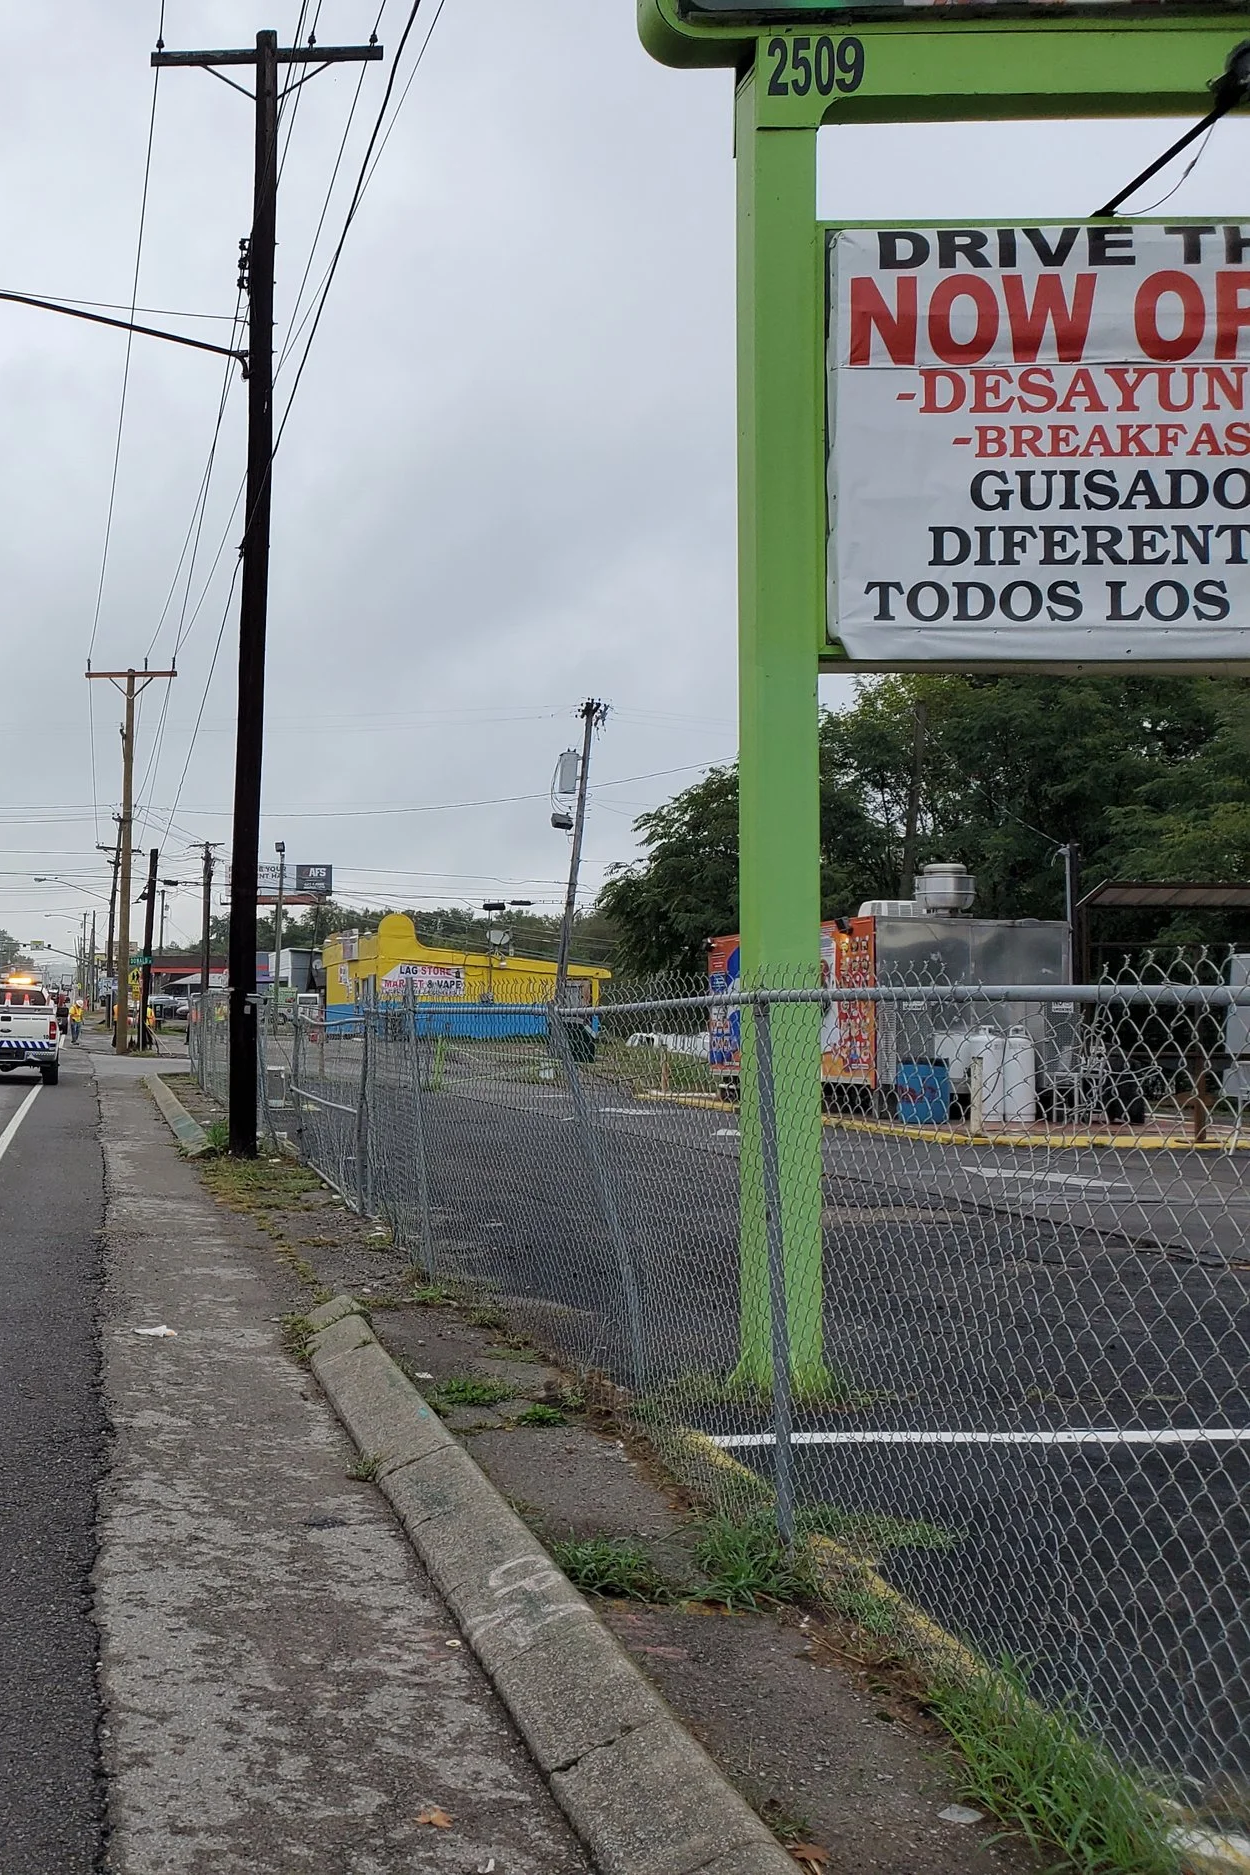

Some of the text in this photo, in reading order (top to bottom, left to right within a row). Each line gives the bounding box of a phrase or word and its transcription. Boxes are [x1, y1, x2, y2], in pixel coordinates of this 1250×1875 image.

[767, 36, 865, 96] 2509
[878, 227, 1136, 270] DRIVE
[849, 270, 1250, 366] NOW OP
[970, 468, 1250, 511] GUISADO
[928, 525, 1250, 566] DIFERENT
[864, 580, 1231, 622] TODOS LOS
[309, 867, 327, 877] AFS
[384, 979, 424, 989] MARET
[437, 980, 462, 989] VAPE
[399, 966, 418, 975] LAG
